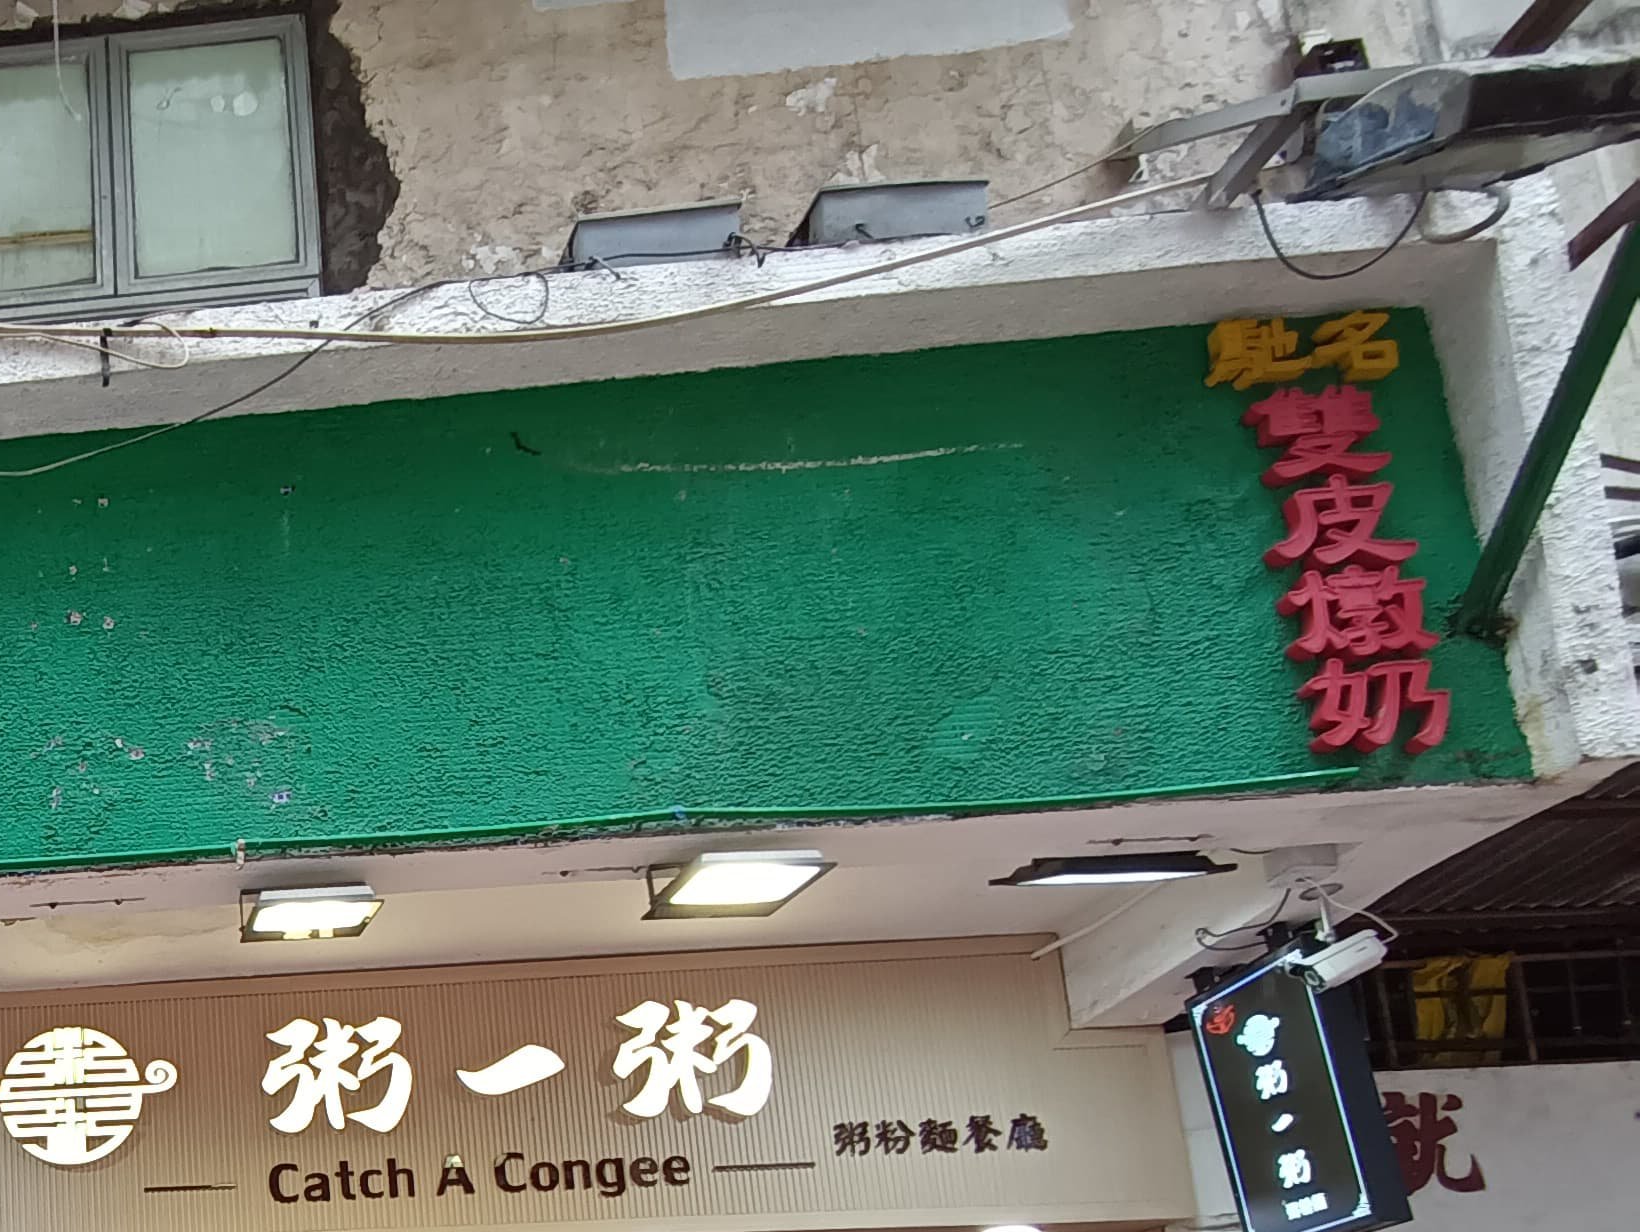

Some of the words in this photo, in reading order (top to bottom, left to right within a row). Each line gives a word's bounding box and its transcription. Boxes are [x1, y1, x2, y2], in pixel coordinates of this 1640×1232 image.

[1205, 310, 1400, 390] 馳名
[261, 998, 773, 1134] 粥一粥
[833, 1112, 1049, 1157] 粥粉麵餐廳
[268, 1157, 416, 1203] Catch
[436, 1154, 474, 1197] A
[494, 1152, 691, 1198] Congee
